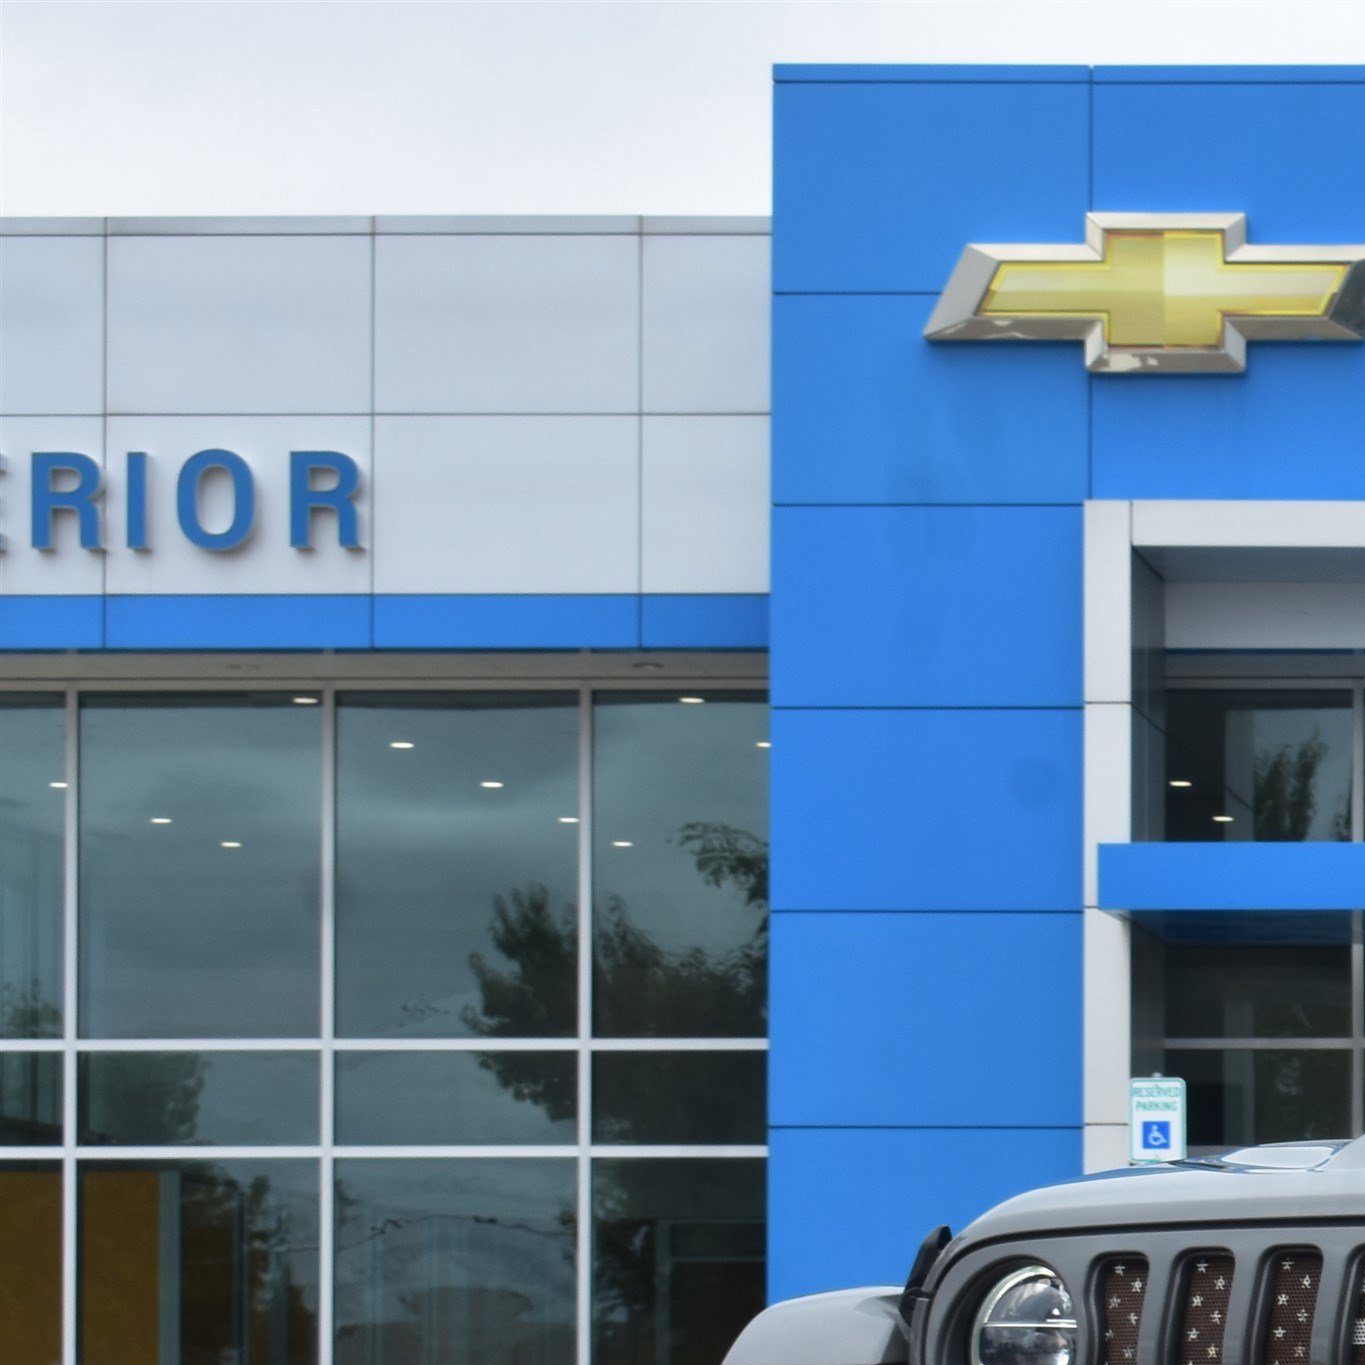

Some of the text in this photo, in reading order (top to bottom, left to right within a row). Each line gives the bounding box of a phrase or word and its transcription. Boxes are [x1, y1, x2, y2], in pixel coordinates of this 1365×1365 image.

[0, 448, 362, 552] RIOR
[1131, 1086, 1180, 1098] RESERVED
[1136, 1101, 1178, 1112] PARKING
